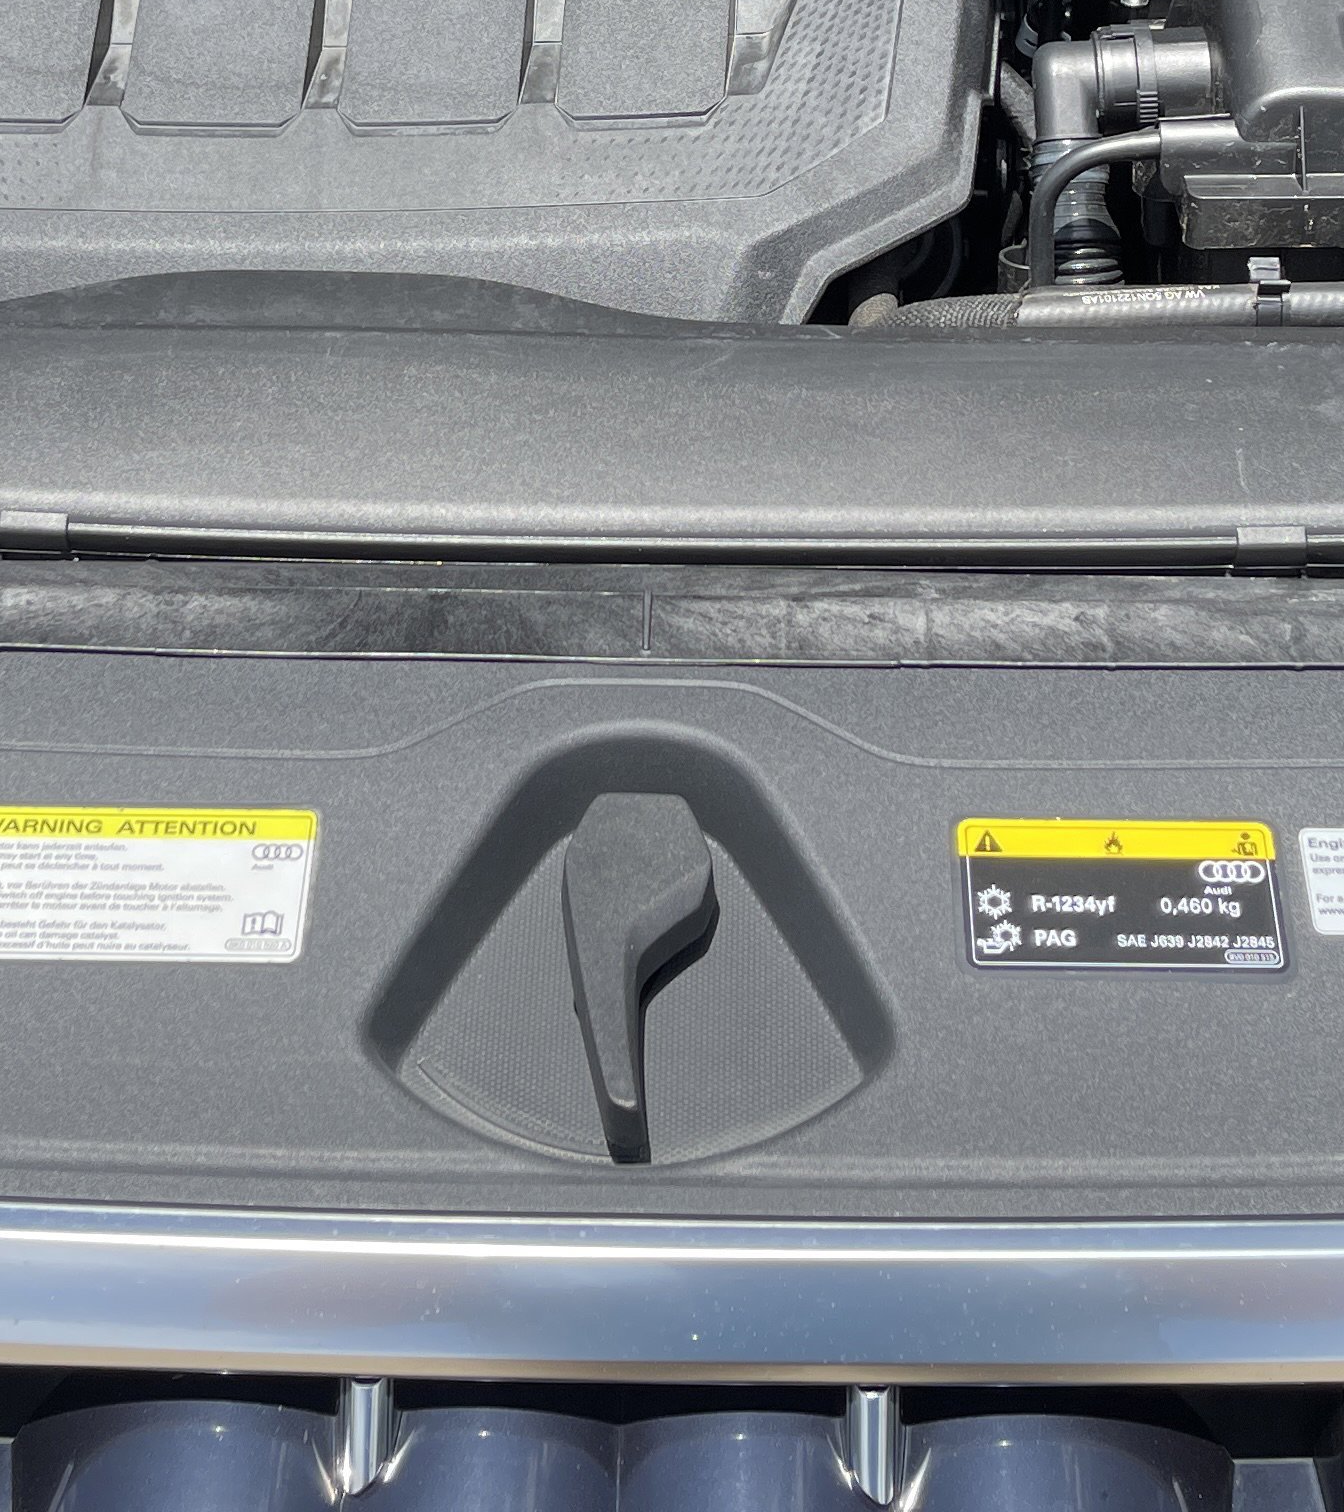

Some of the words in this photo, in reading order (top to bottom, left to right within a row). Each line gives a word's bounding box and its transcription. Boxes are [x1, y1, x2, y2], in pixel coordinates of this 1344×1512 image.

[116, 819, 258, 836] ATTENTION
[1309, 853, 1331, 863] Use
[1203, 885, 1232, 895] Audi
[1316, 893, 1335, 903] For
[1337, 895, 1344, 904] a
[1031, 894, 1116, 916] R-1234yf
[1159, 897, 1213, 916] 0,460
[1218, 897, 1241, 918] kg
[1033, 929, 1077, 946] PAG
[1116, 935, 1147, 948] SAE
[1150, 935, 1185, 948] J639
[1188, 935, 1230, 949] J2842
[1232, 935, 1276, 949] J2845
